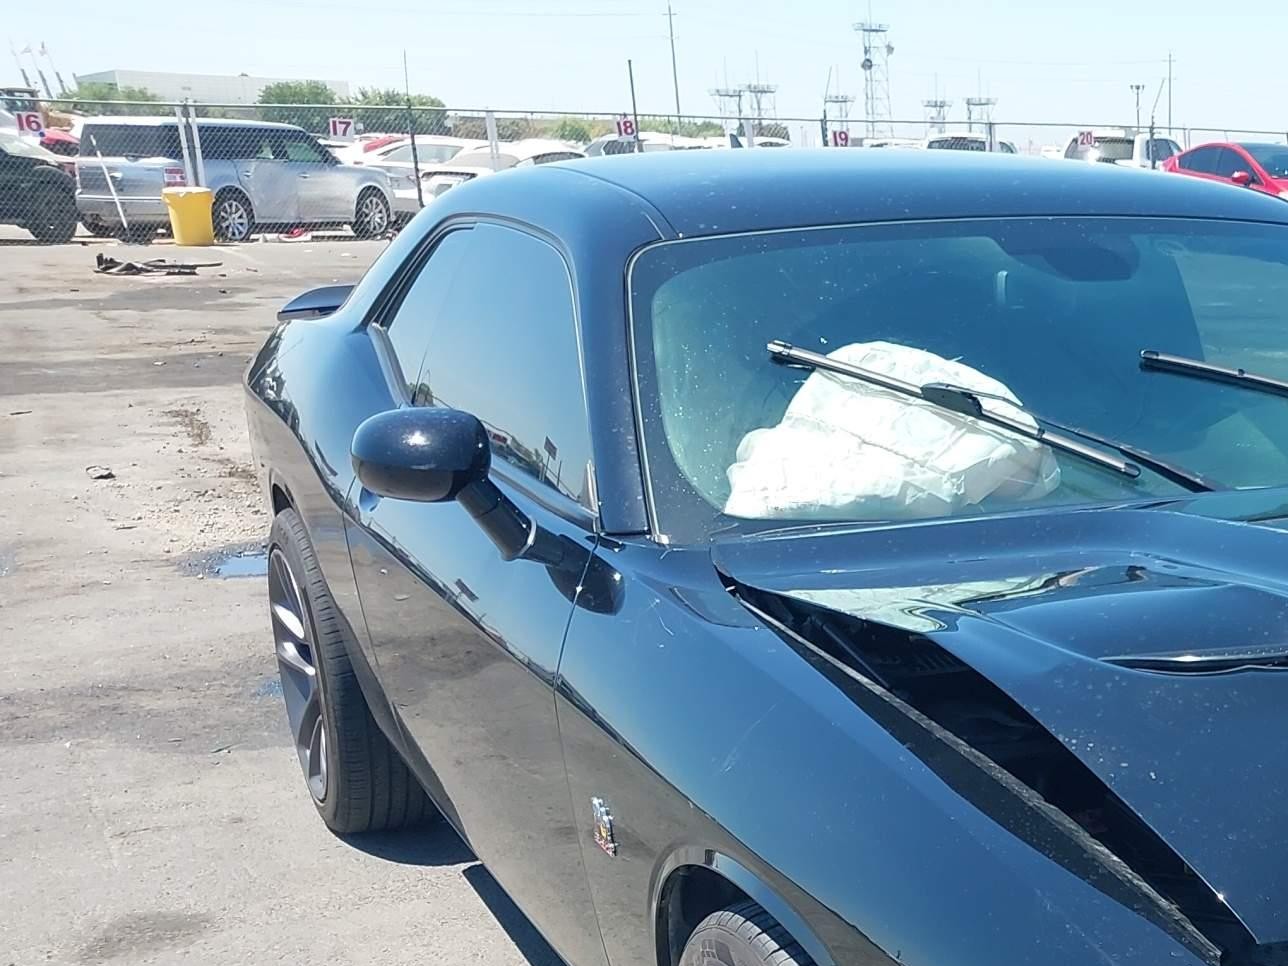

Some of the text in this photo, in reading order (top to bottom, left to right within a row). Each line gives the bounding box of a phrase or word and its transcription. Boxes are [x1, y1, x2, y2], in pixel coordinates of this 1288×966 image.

[16, 113, 42, 132] 16
[332, 120, 352, 137] 17
[616, 120, 635, 138] 18
[833, 131, 848, 147] 19
[1079, 131, 1093, 145] 20
